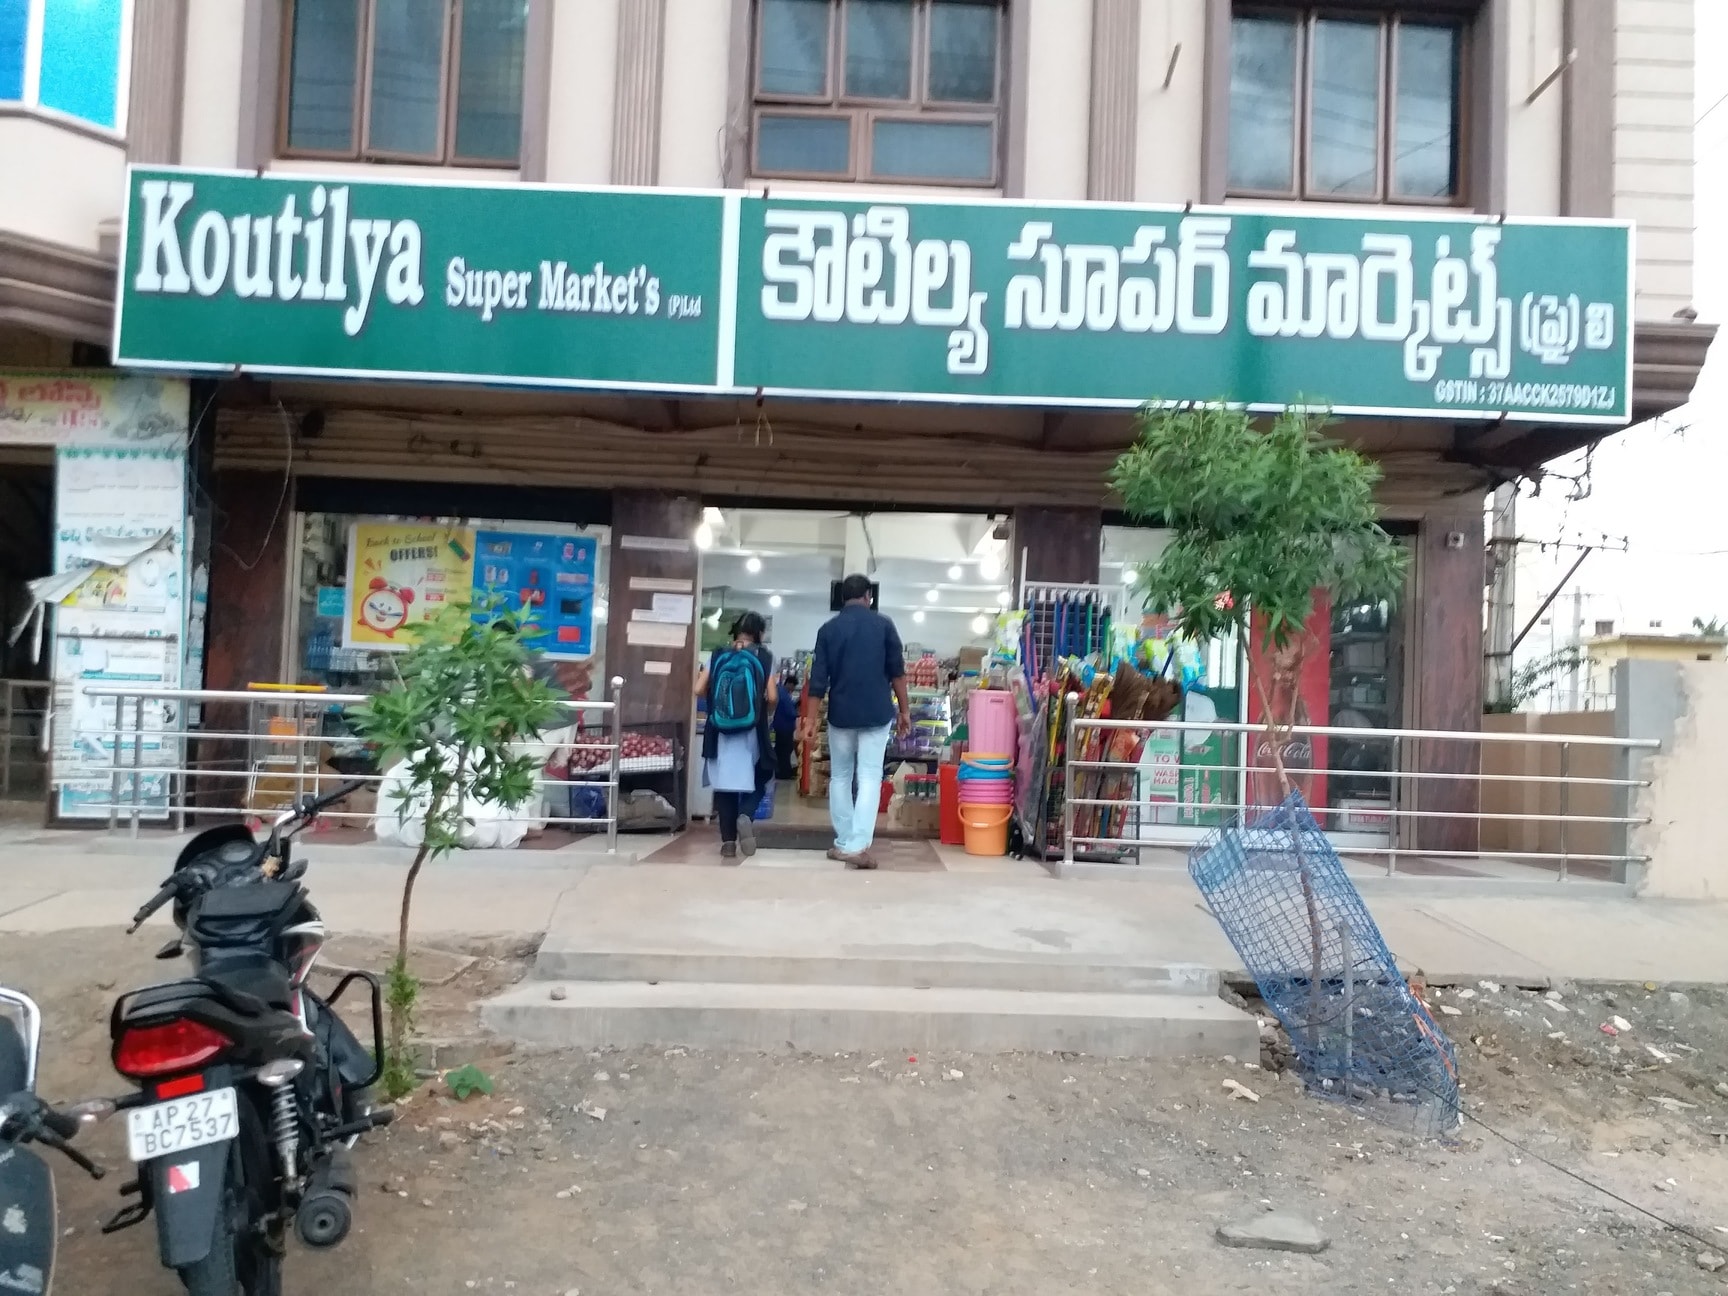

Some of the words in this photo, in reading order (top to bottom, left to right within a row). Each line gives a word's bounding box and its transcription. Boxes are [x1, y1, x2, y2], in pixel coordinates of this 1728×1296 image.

[134, 181, 424, 337] Koutilya
[1004, 216, 1232, 334] సూపర్
[446, 256, 532, 321] Super
[538, 260, 660, 315] Market's
[1434, 379, 1478, 403] GSTIN
[144, 1113, 232, 1153] BC7537
[153, 1106, 178, 1130] AP
[186, 1097, 213, 1123] 27
